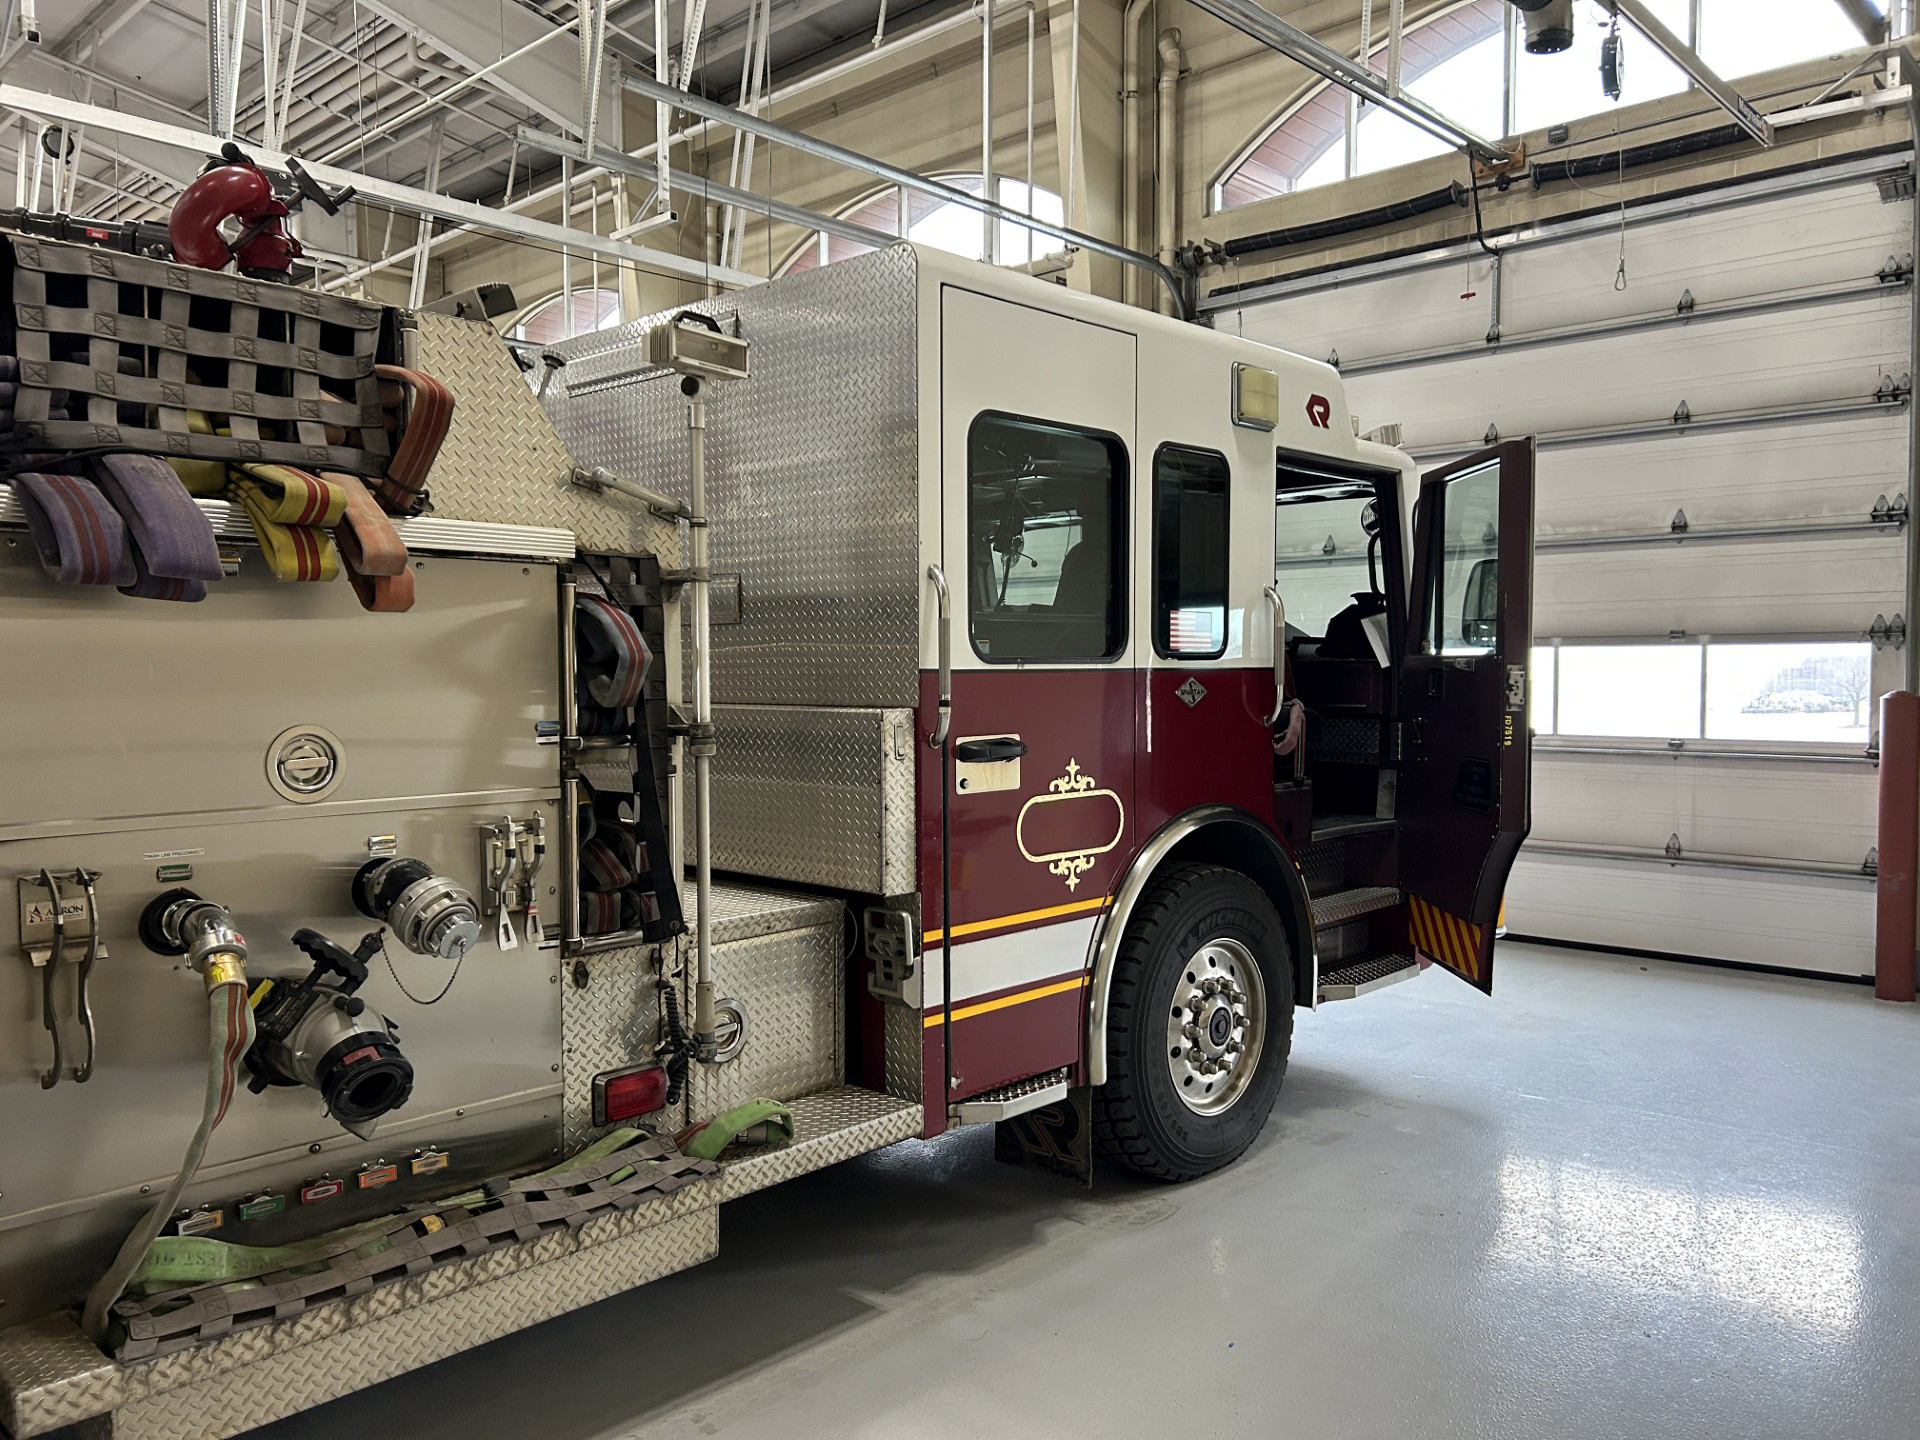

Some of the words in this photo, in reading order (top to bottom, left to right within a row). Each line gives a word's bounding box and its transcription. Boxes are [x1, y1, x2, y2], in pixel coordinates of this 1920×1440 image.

[1504, 715, 1512, 746] FD7519
[171, 849, 204, 857] PRECONNECT
[46, 905, 83, 916] ARON
